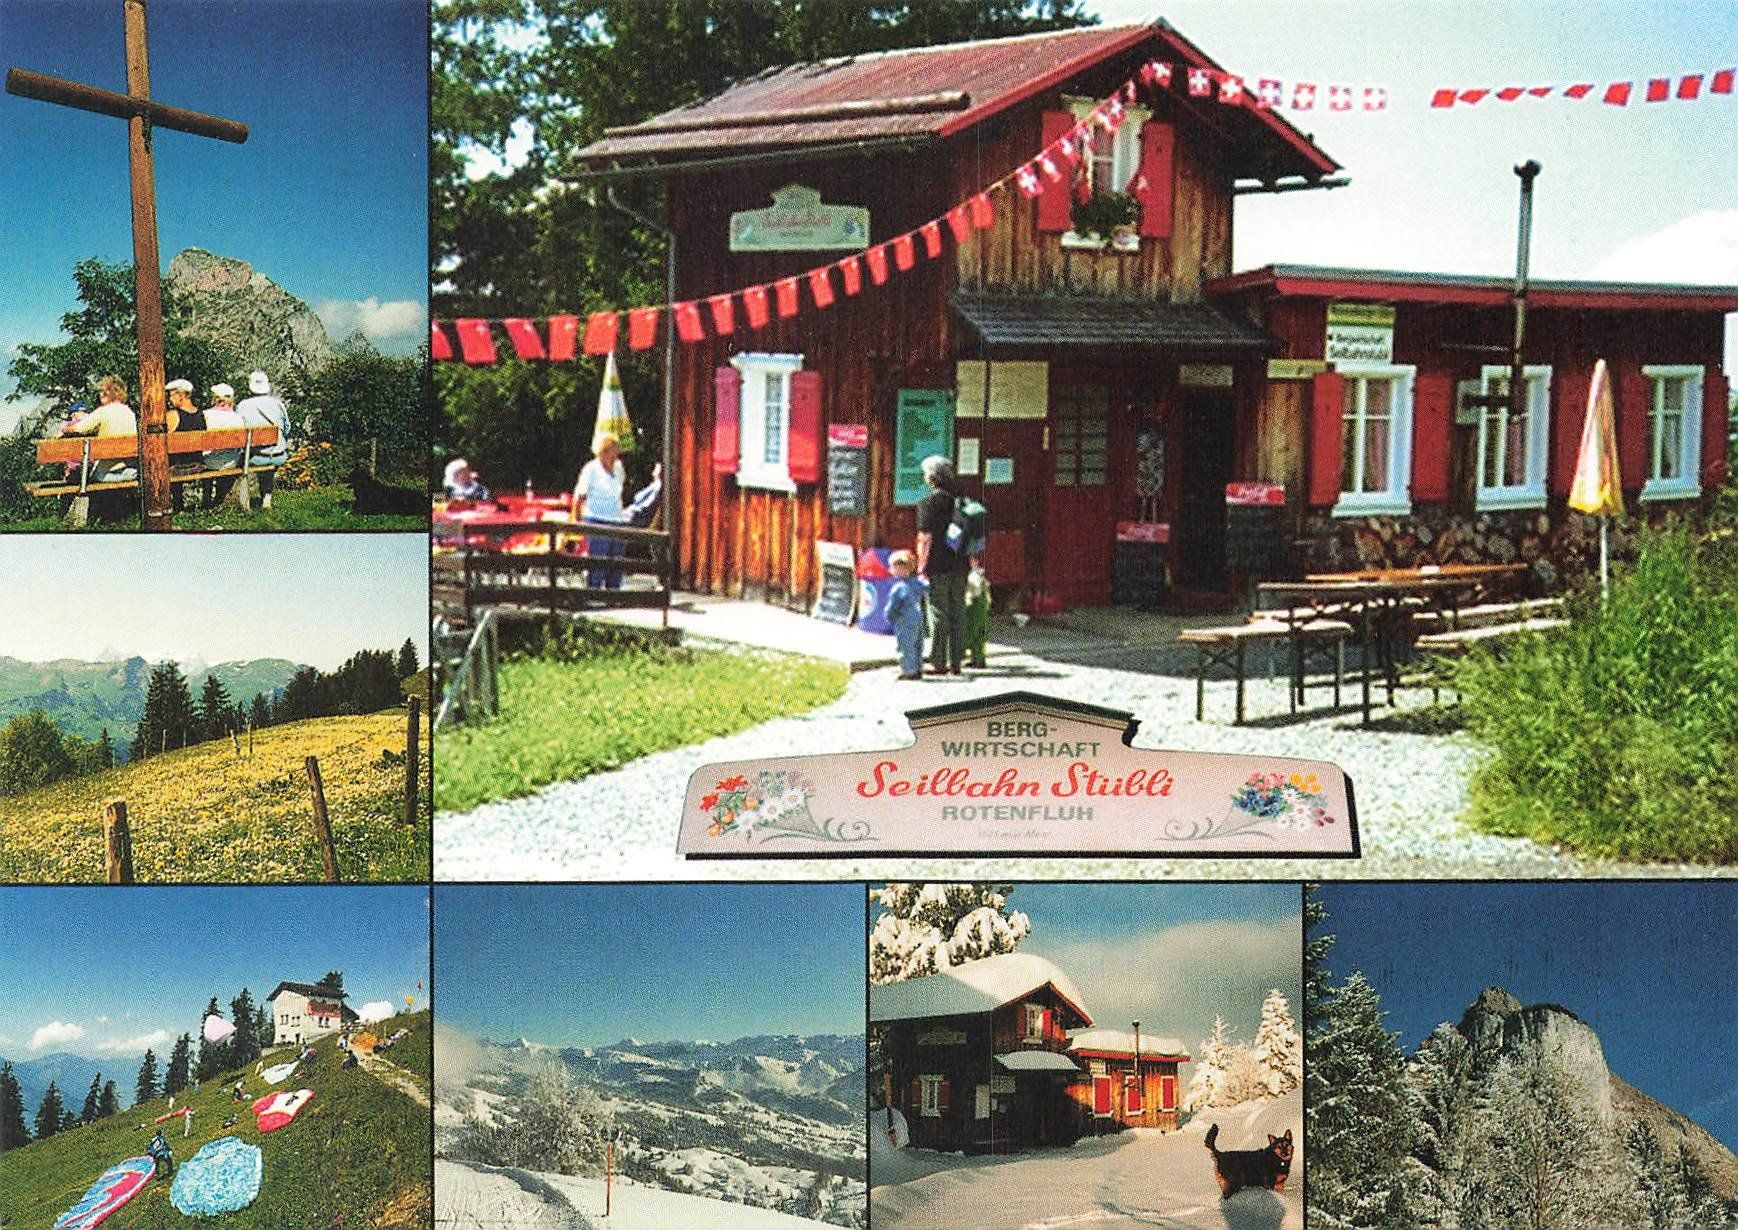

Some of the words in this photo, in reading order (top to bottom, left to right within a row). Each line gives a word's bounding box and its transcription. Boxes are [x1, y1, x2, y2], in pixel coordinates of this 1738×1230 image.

[987, 721, 1058, 737] BERG-
[941, 741, 1101, 757] WIRTSCHAFT
[856, 761, 1041, 798] Seilbahn
[1051, 761, 1174, 798] Stübli
[941, 806, 1094, 821] ROTENFLUH
